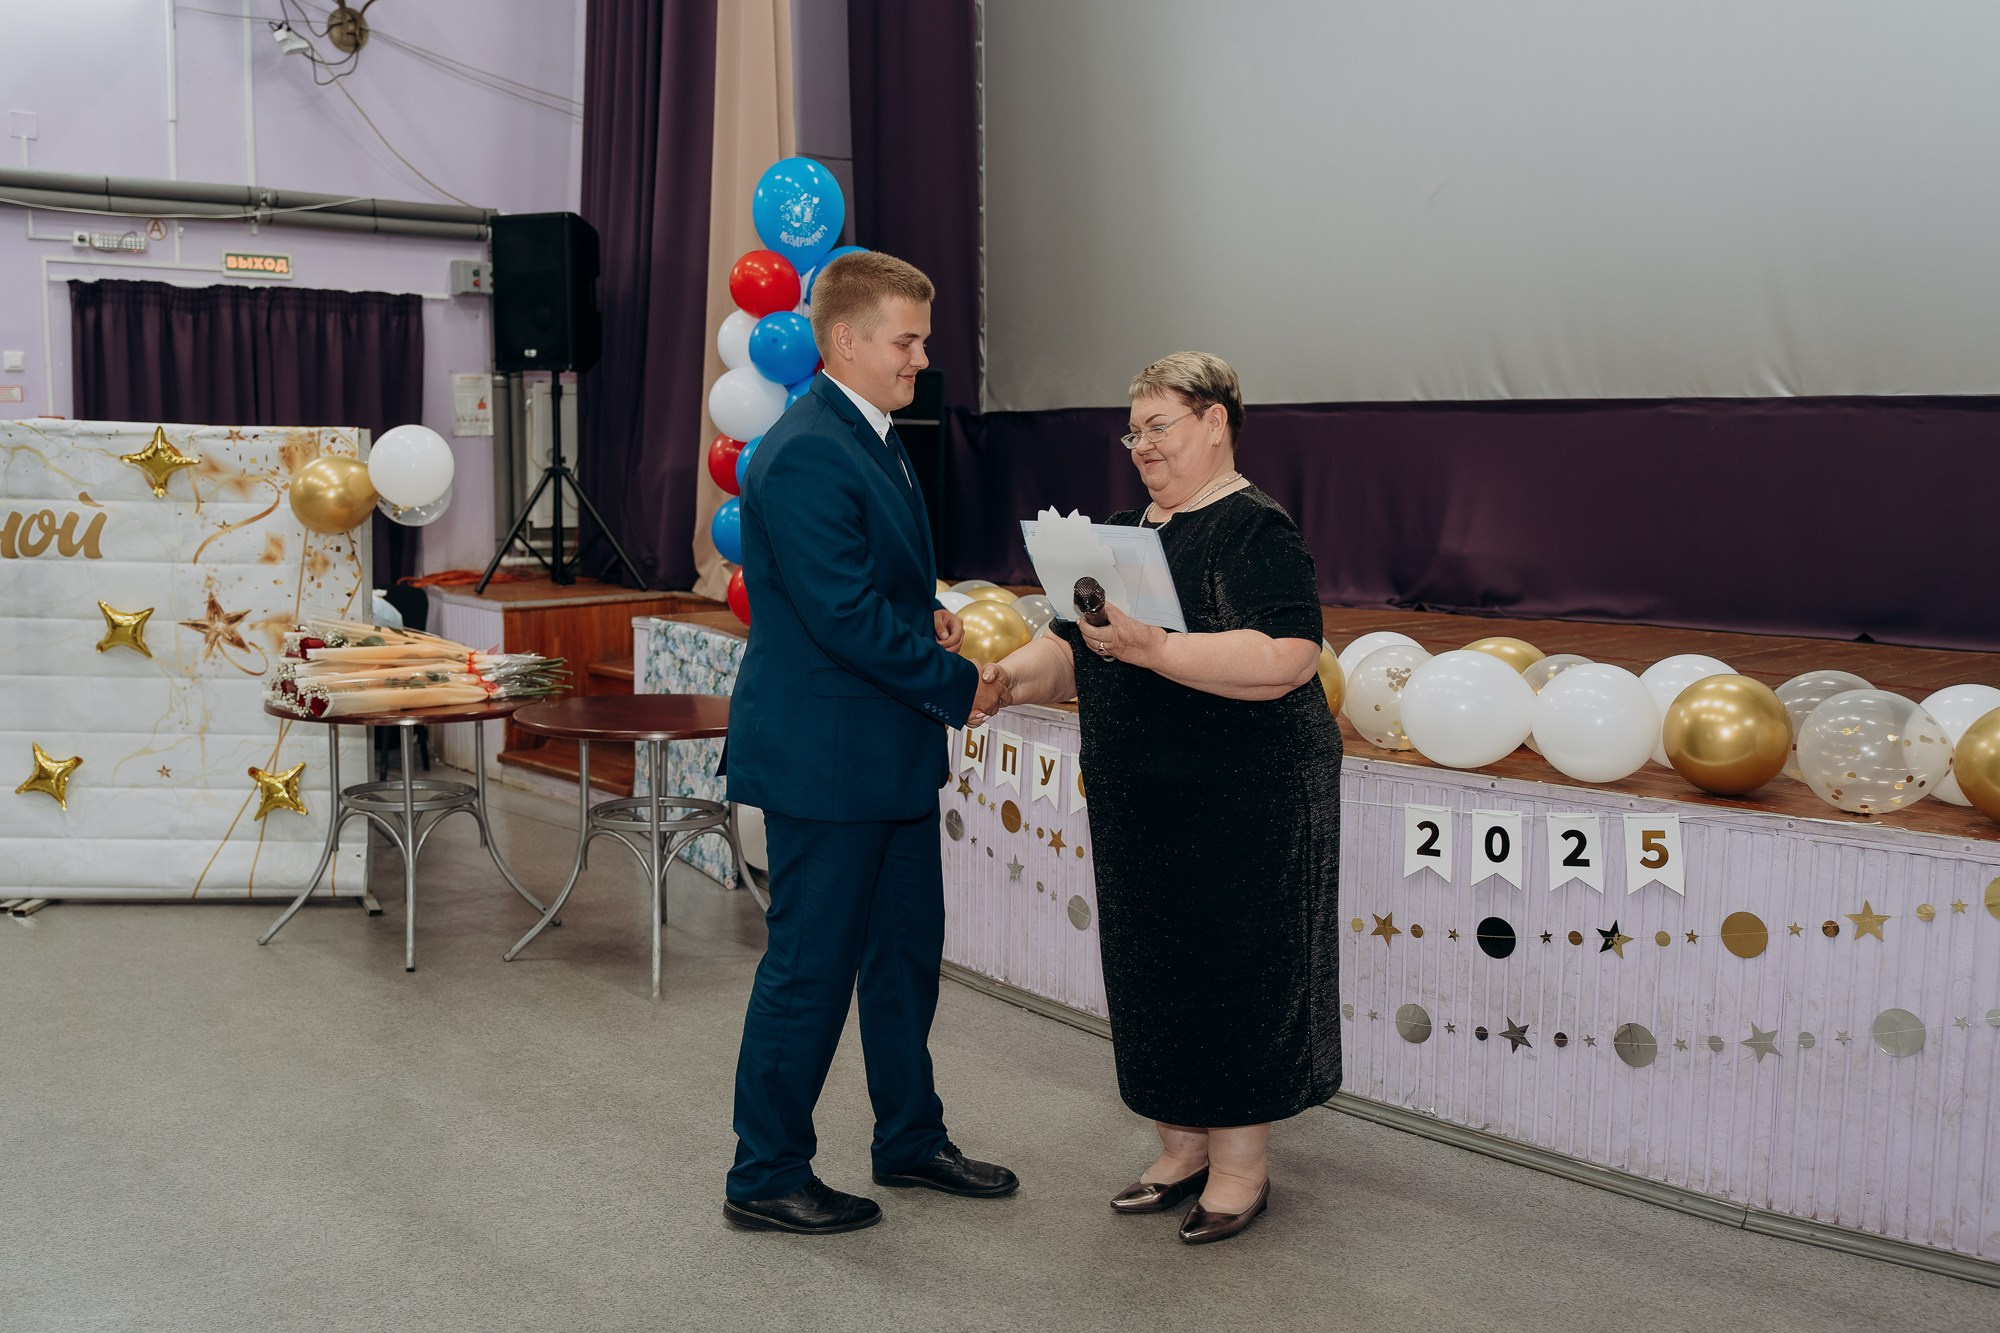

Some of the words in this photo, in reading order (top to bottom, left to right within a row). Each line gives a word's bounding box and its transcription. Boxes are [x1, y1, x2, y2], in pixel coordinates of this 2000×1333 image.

[226, 255, 289, 273] ВЫХОД
[945, 725, 1087, 799] ЫПУ
[1416, 820, 1669, 869] 2025
